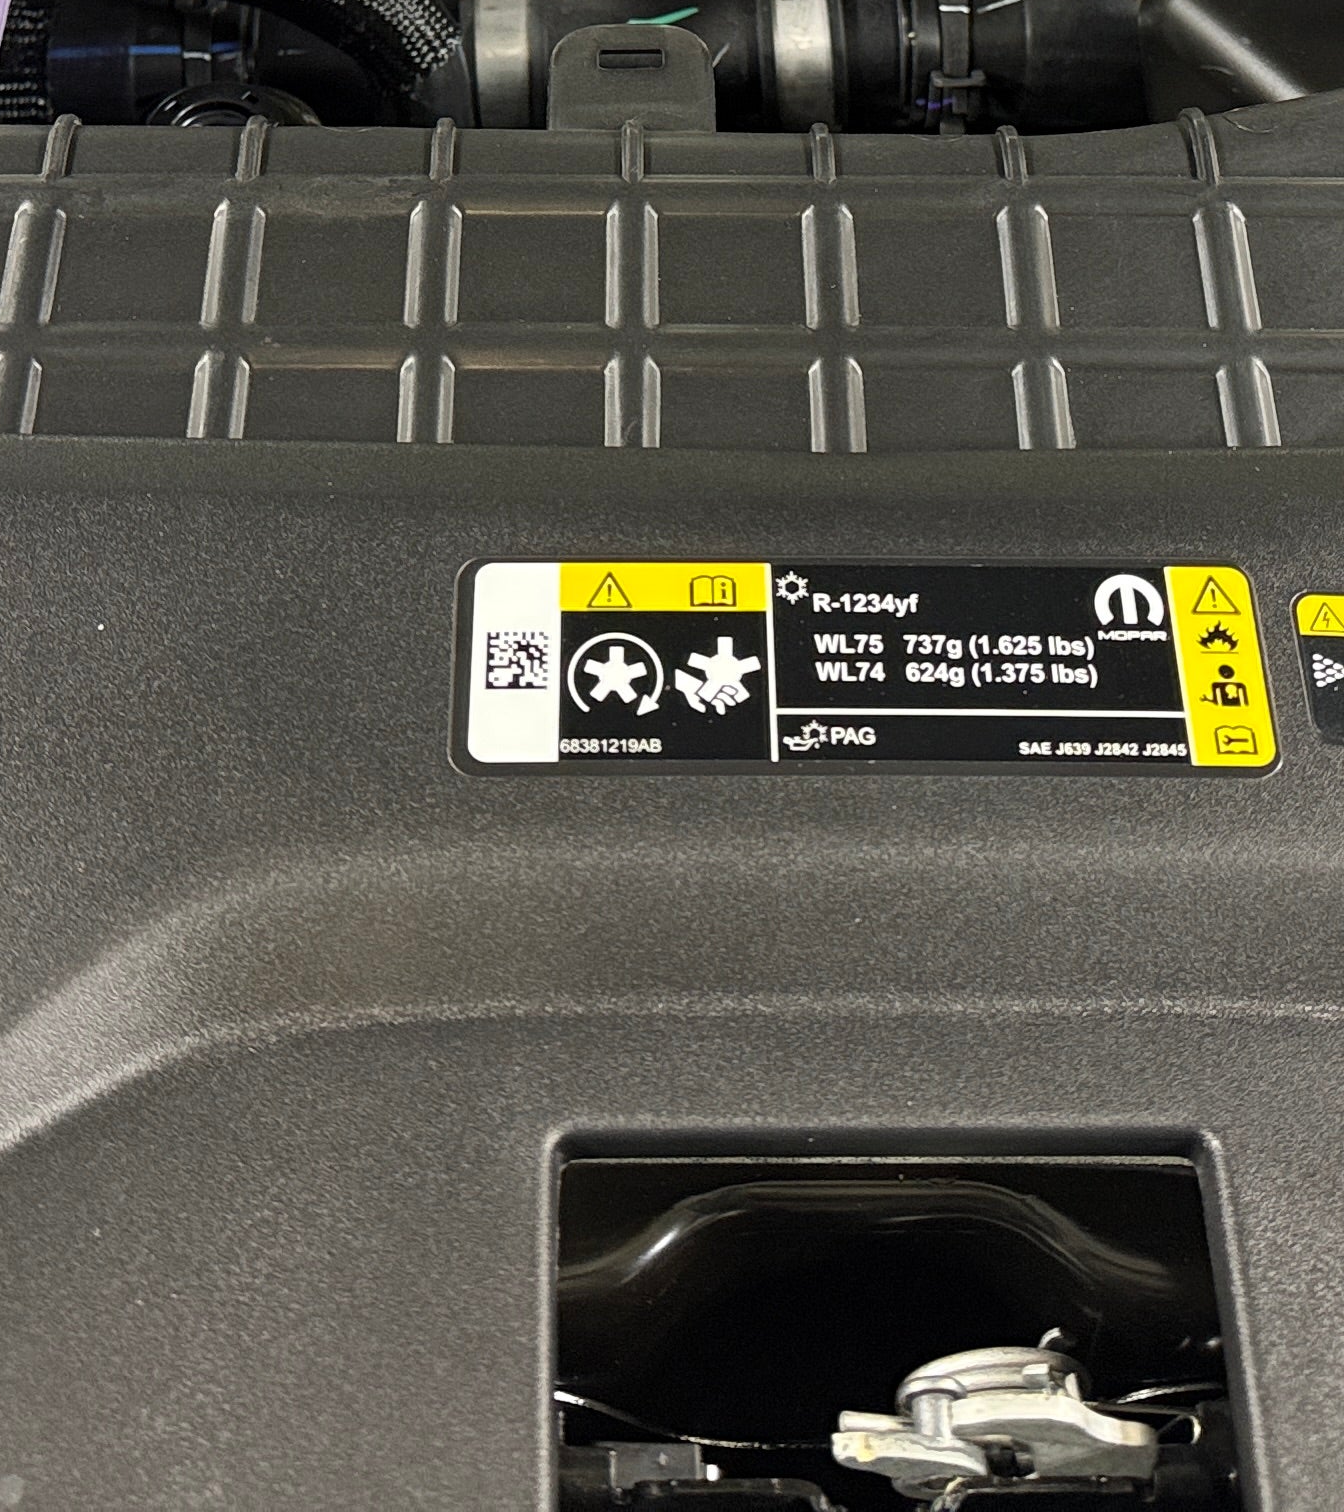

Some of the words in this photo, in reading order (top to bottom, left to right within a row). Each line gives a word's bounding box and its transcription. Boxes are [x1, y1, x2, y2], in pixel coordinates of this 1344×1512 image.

[812, 592, 920, 618] R-1234yf
[1097, 629, 1168, 642] MOPAR
[813, 633, 885, 655] WL75
[902, 633, 964, 660] 737g
[968, 634, 1043, 660] (1.625
[1048, 635, 1096, 661] lbs)
[814, 661, 887, 683] WL74
[905, 661, 966, 688] 624g
[971, 663, 1046, 688] (1.375
[1051, 663, 1099, 689] lbs)
[559, 737, 664, 754] 68381219AB
[830, 726, 877, 746] PAG
[1018, 740, 1053, 757] SAE
[1055, 742, 1092, 757] J639
[1094, 742, 1140, 757] J2842
[1142, 743, 1188, 758] J2845
